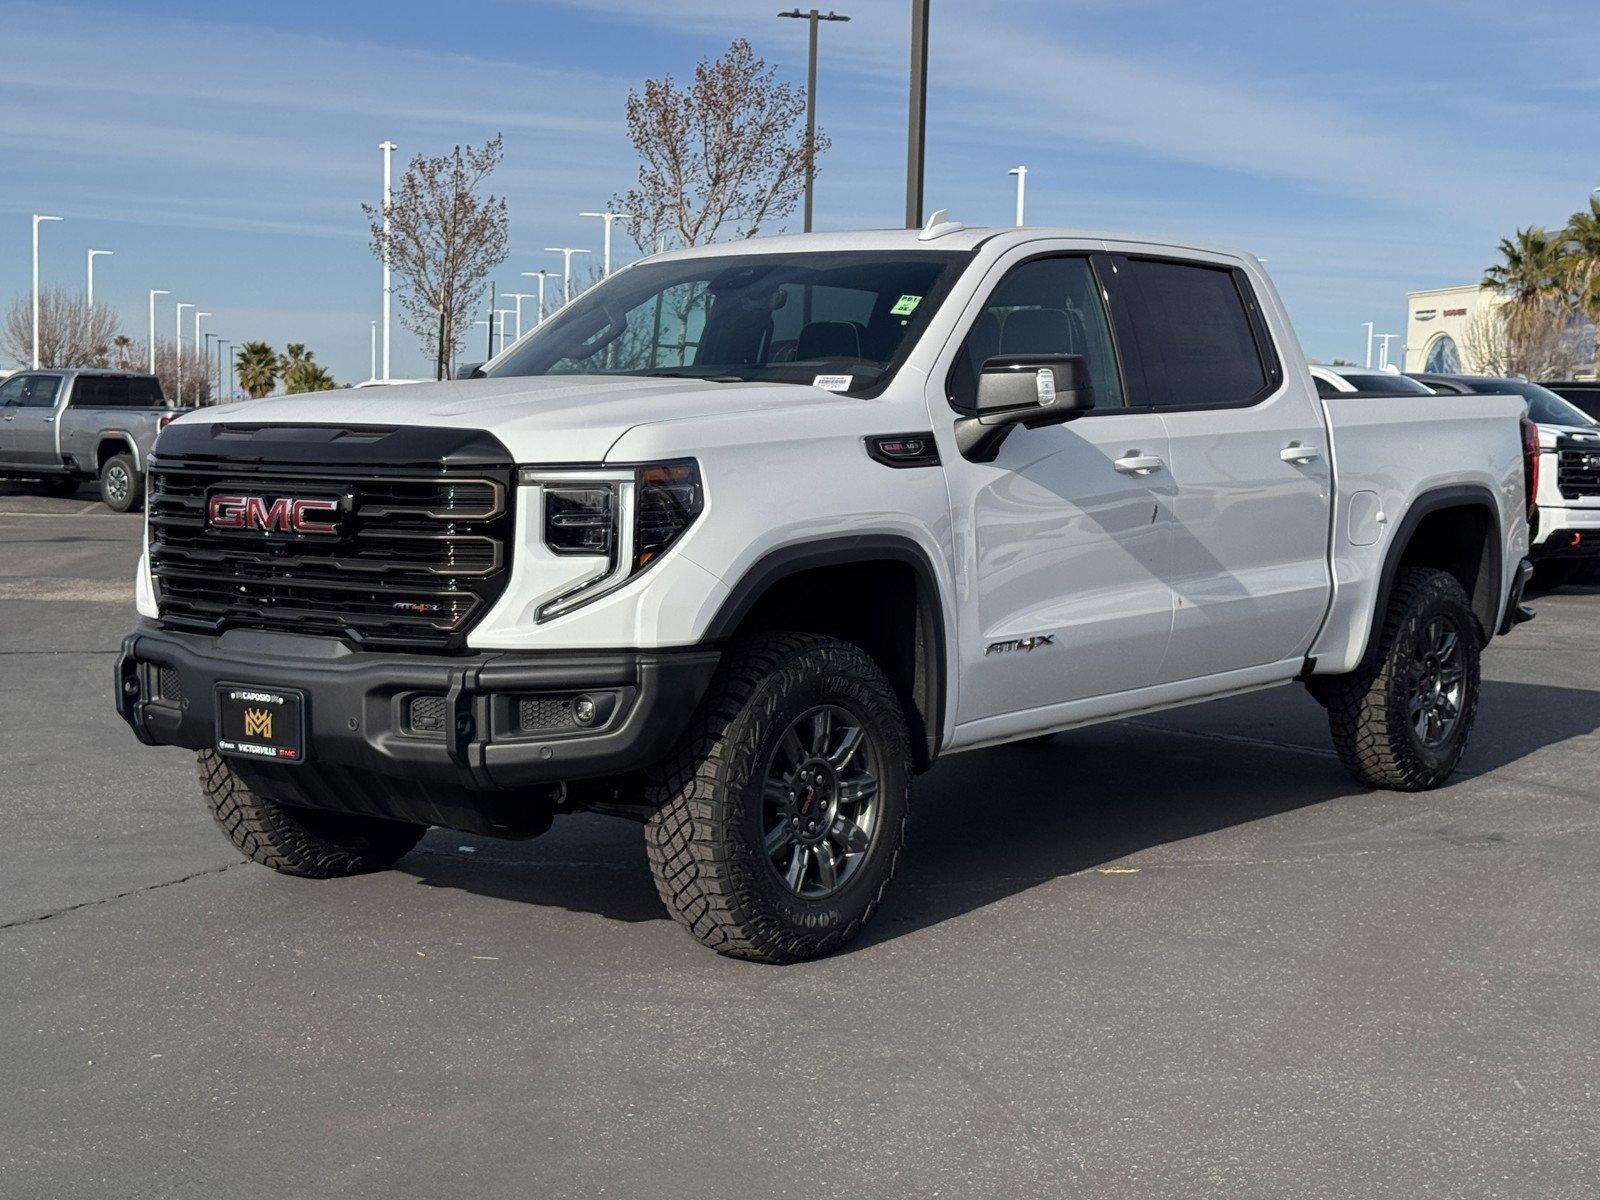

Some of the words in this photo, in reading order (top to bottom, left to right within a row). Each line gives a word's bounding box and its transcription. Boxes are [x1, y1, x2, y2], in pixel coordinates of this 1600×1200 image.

[208, 494, 338, 534] GMC
[242, 691, 271, 702] CAPOSIO
[238, 743, 276, 756] VICTORVILLE
